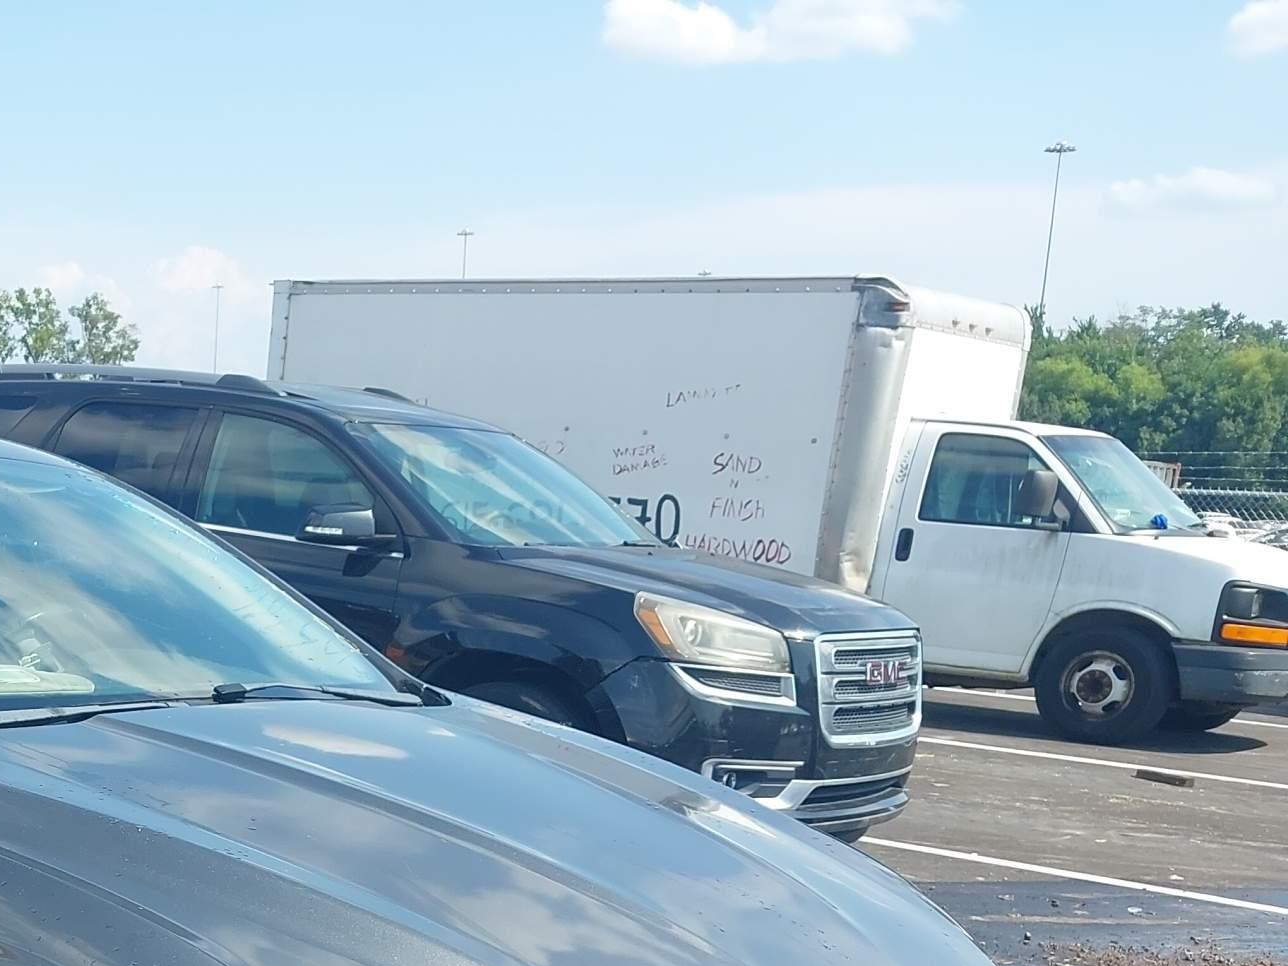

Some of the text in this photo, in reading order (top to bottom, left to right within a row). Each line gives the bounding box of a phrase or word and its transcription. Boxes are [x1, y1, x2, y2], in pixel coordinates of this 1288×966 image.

[712, 452, 762, 475] SAND
[684, 533, 792, 565] HARDWOOD
[866, 659, 909, 685] GMC
